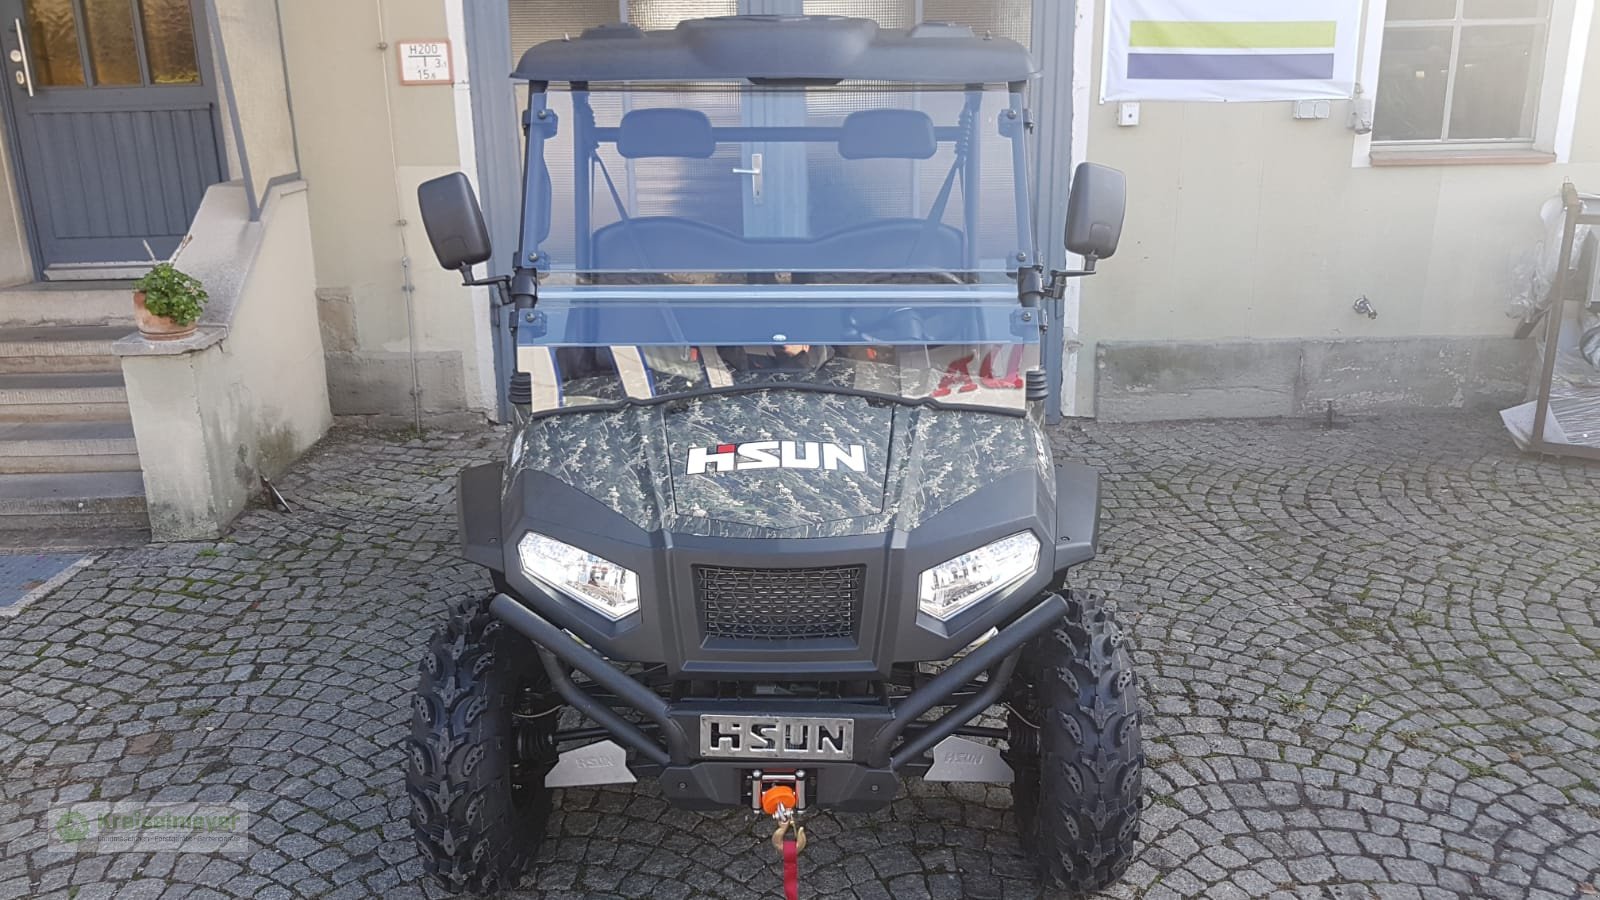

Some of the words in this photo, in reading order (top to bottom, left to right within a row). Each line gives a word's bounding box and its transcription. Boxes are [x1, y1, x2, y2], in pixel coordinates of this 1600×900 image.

[409, 44, 438, 55] H200
[686, 440, 867, 475] HSUN
[710, 722, 844, 753] HSUN
